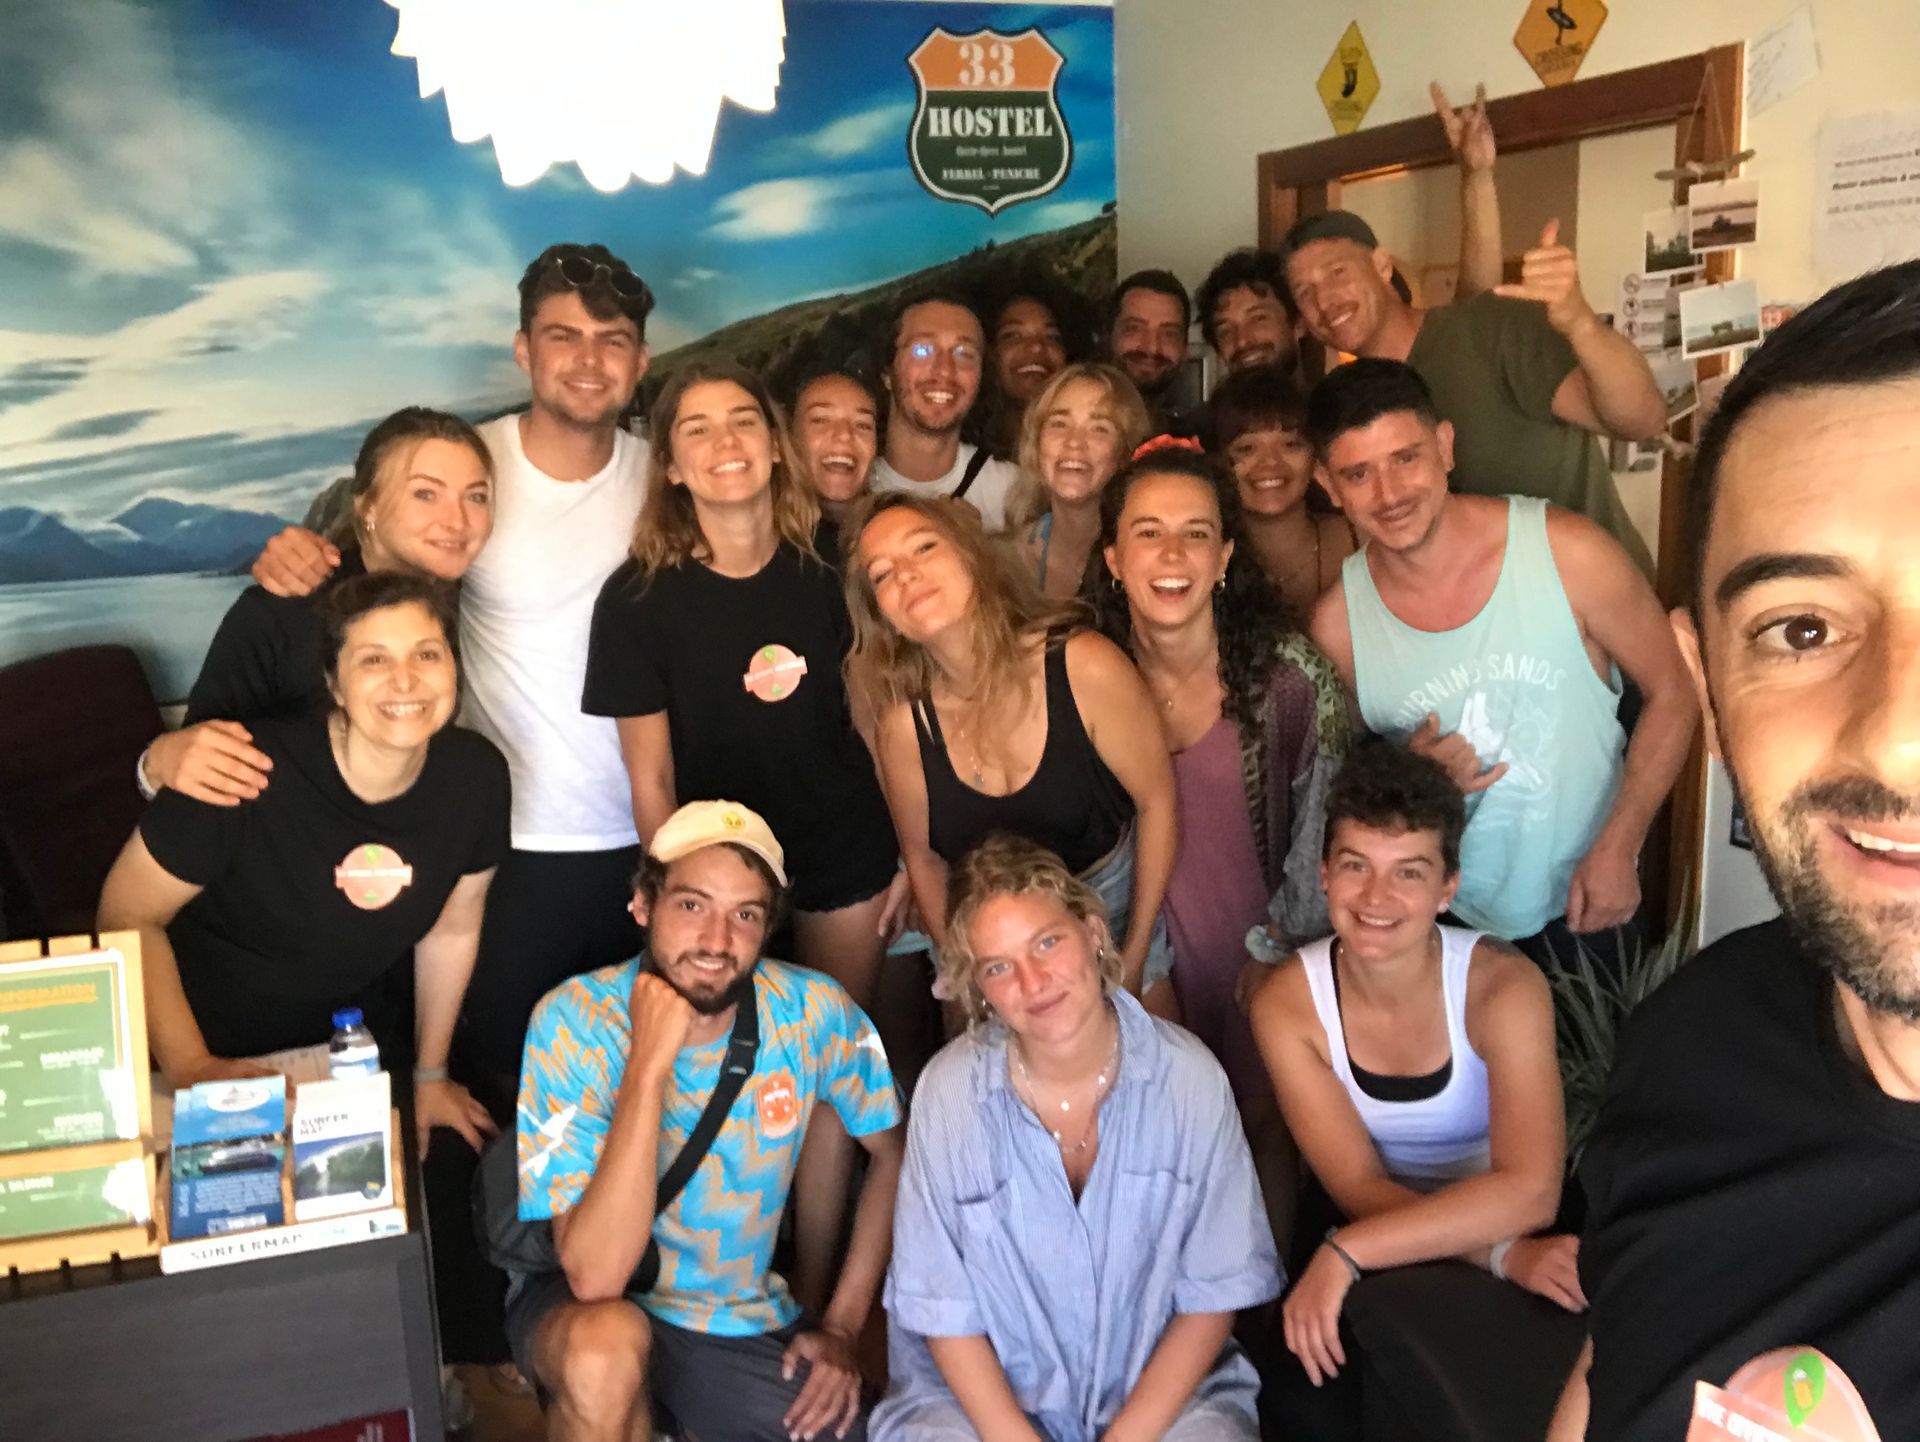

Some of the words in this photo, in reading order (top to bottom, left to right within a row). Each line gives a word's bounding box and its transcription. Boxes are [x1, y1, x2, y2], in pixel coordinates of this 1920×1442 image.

[958, 41, 1016, 87] 33
[927, 106, 1053, 138] HOSTEL
[1488, 652, 1567, 691] SANDS
